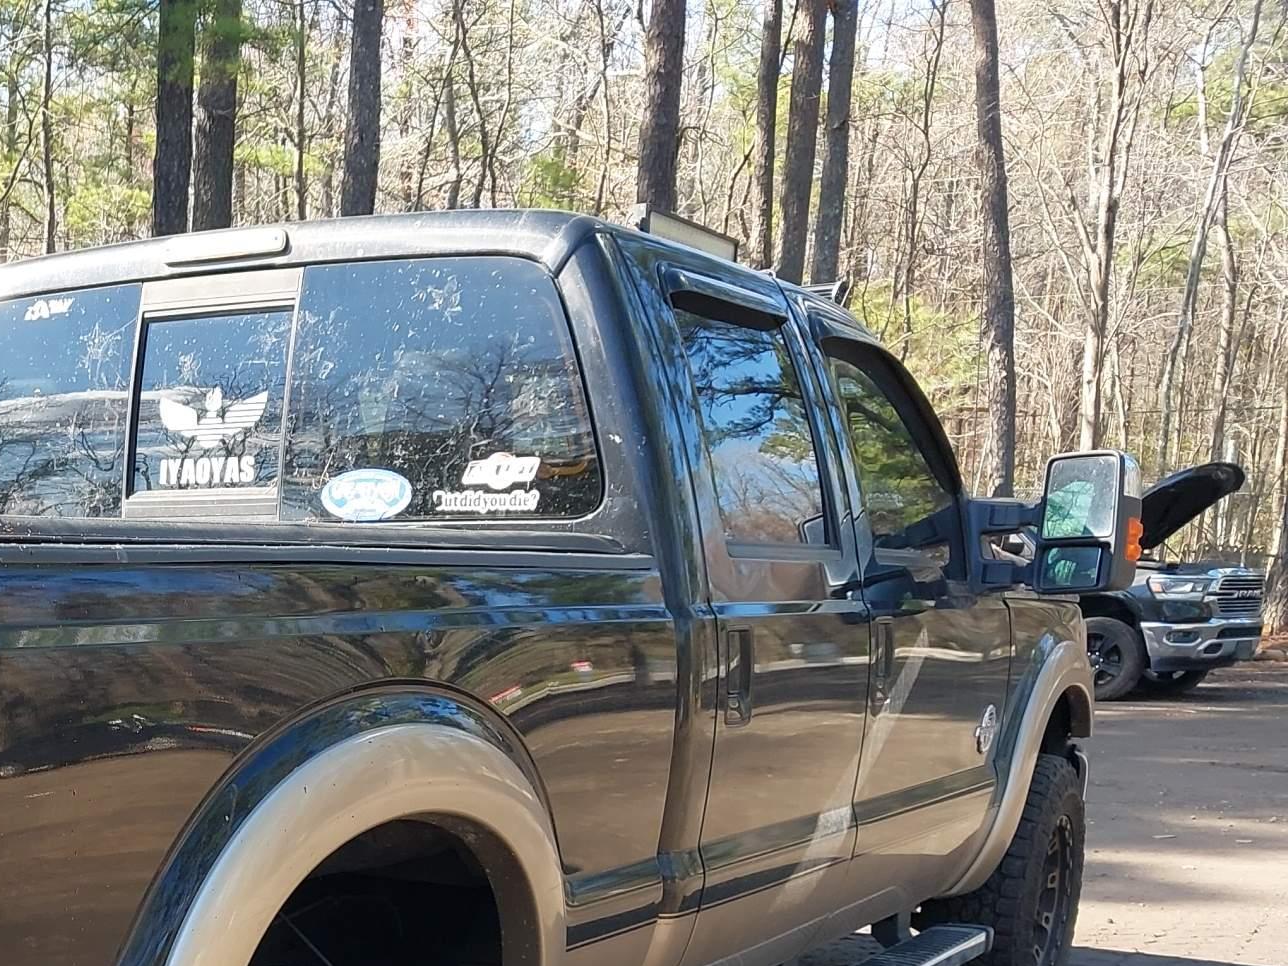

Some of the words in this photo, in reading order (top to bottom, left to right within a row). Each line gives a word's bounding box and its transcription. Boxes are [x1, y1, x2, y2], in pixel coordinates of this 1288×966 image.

[159, 456, 255, 485] IYAOYAS
[460, 494, 481, 507] did
[482, 498, 507, 510] you
[509, 493, 537, 507] die?
[1239, 589, 1262, 599] RAM
